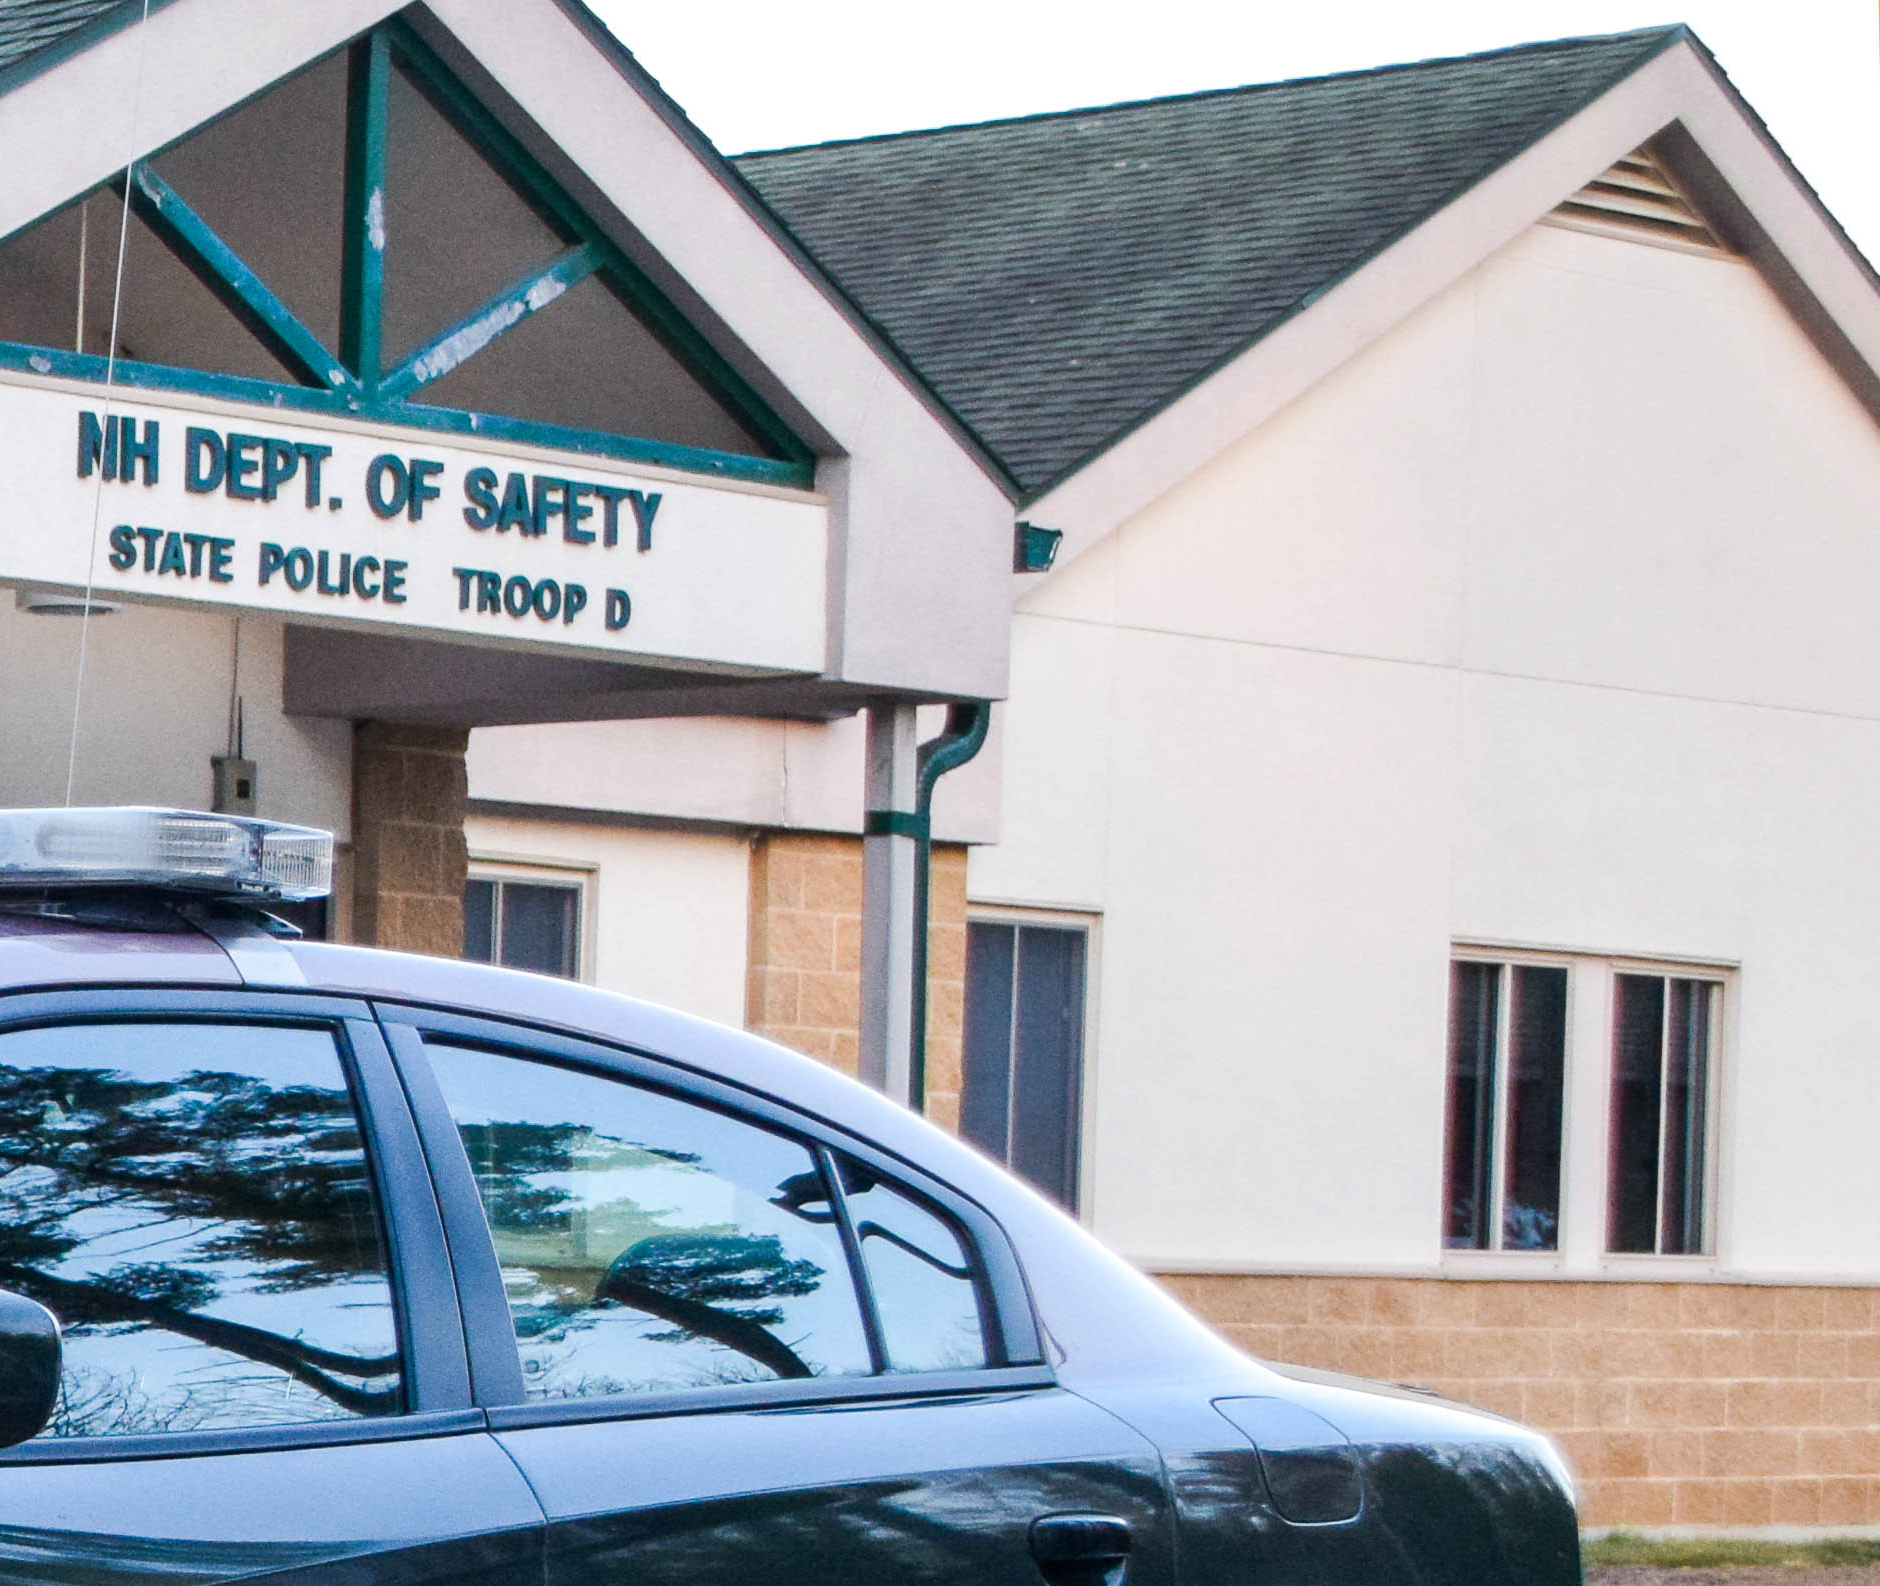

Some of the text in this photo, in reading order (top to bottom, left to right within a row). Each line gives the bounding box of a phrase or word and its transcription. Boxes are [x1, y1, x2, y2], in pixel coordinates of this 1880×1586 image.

[77, 410, 663, 553] NH DEPT. OF SAFETY
[108, 524, 633, 631] STATE POLICE TROOP D
